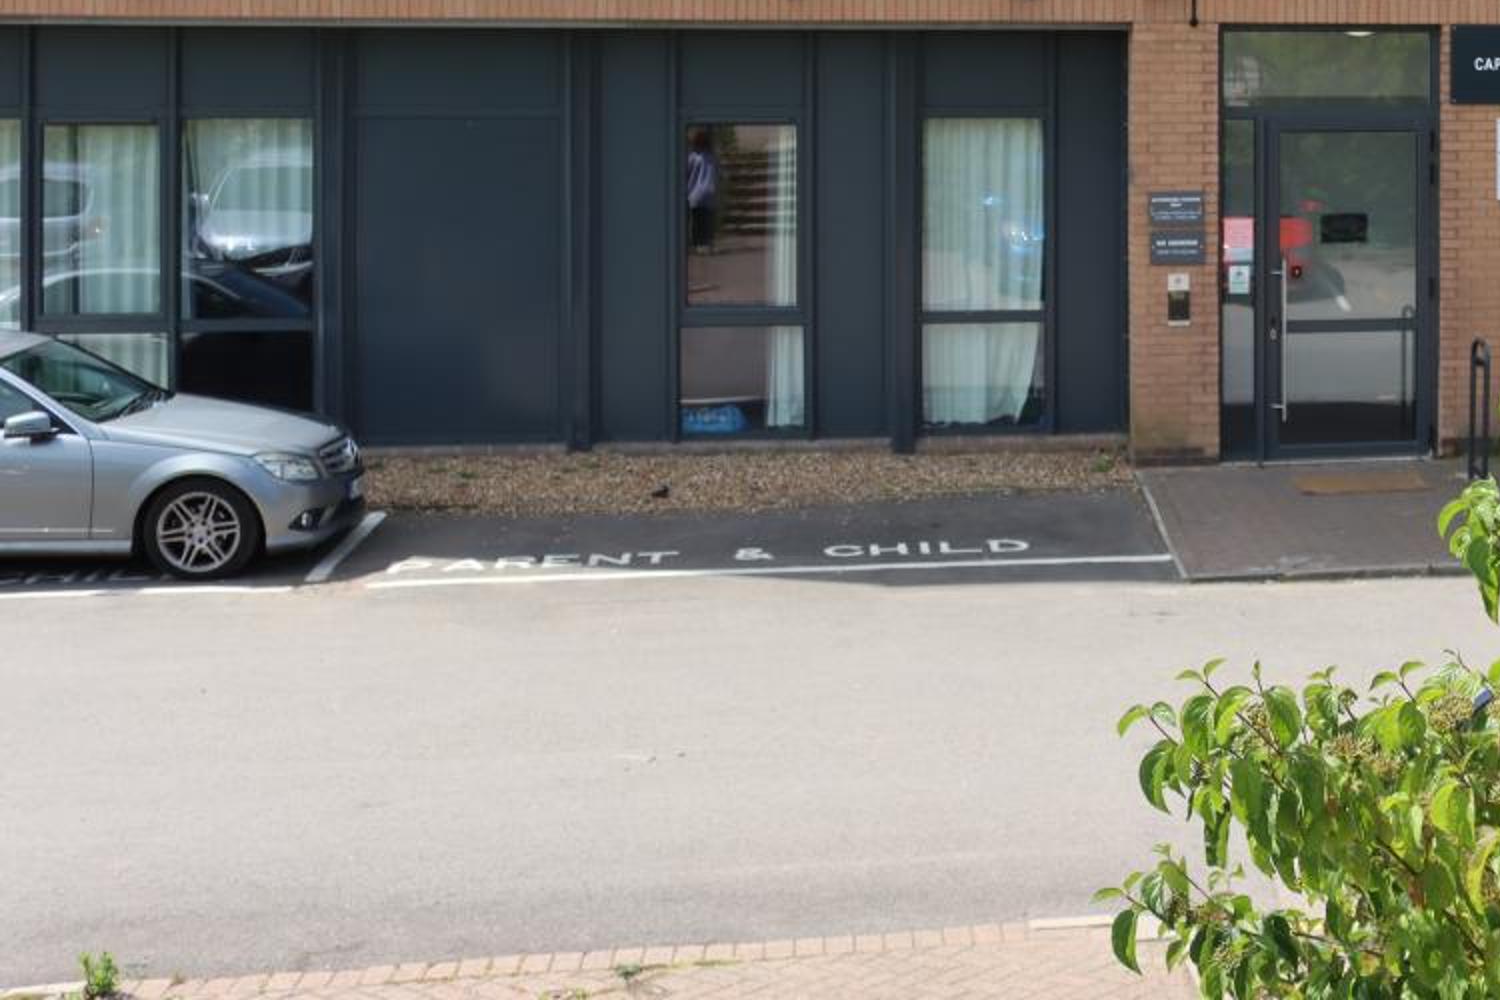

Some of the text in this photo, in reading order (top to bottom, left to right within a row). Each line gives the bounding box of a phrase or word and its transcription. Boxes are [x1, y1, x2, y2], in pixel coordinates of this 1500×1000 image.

[386, 538, 1030, 574] PARENT & CHILD
